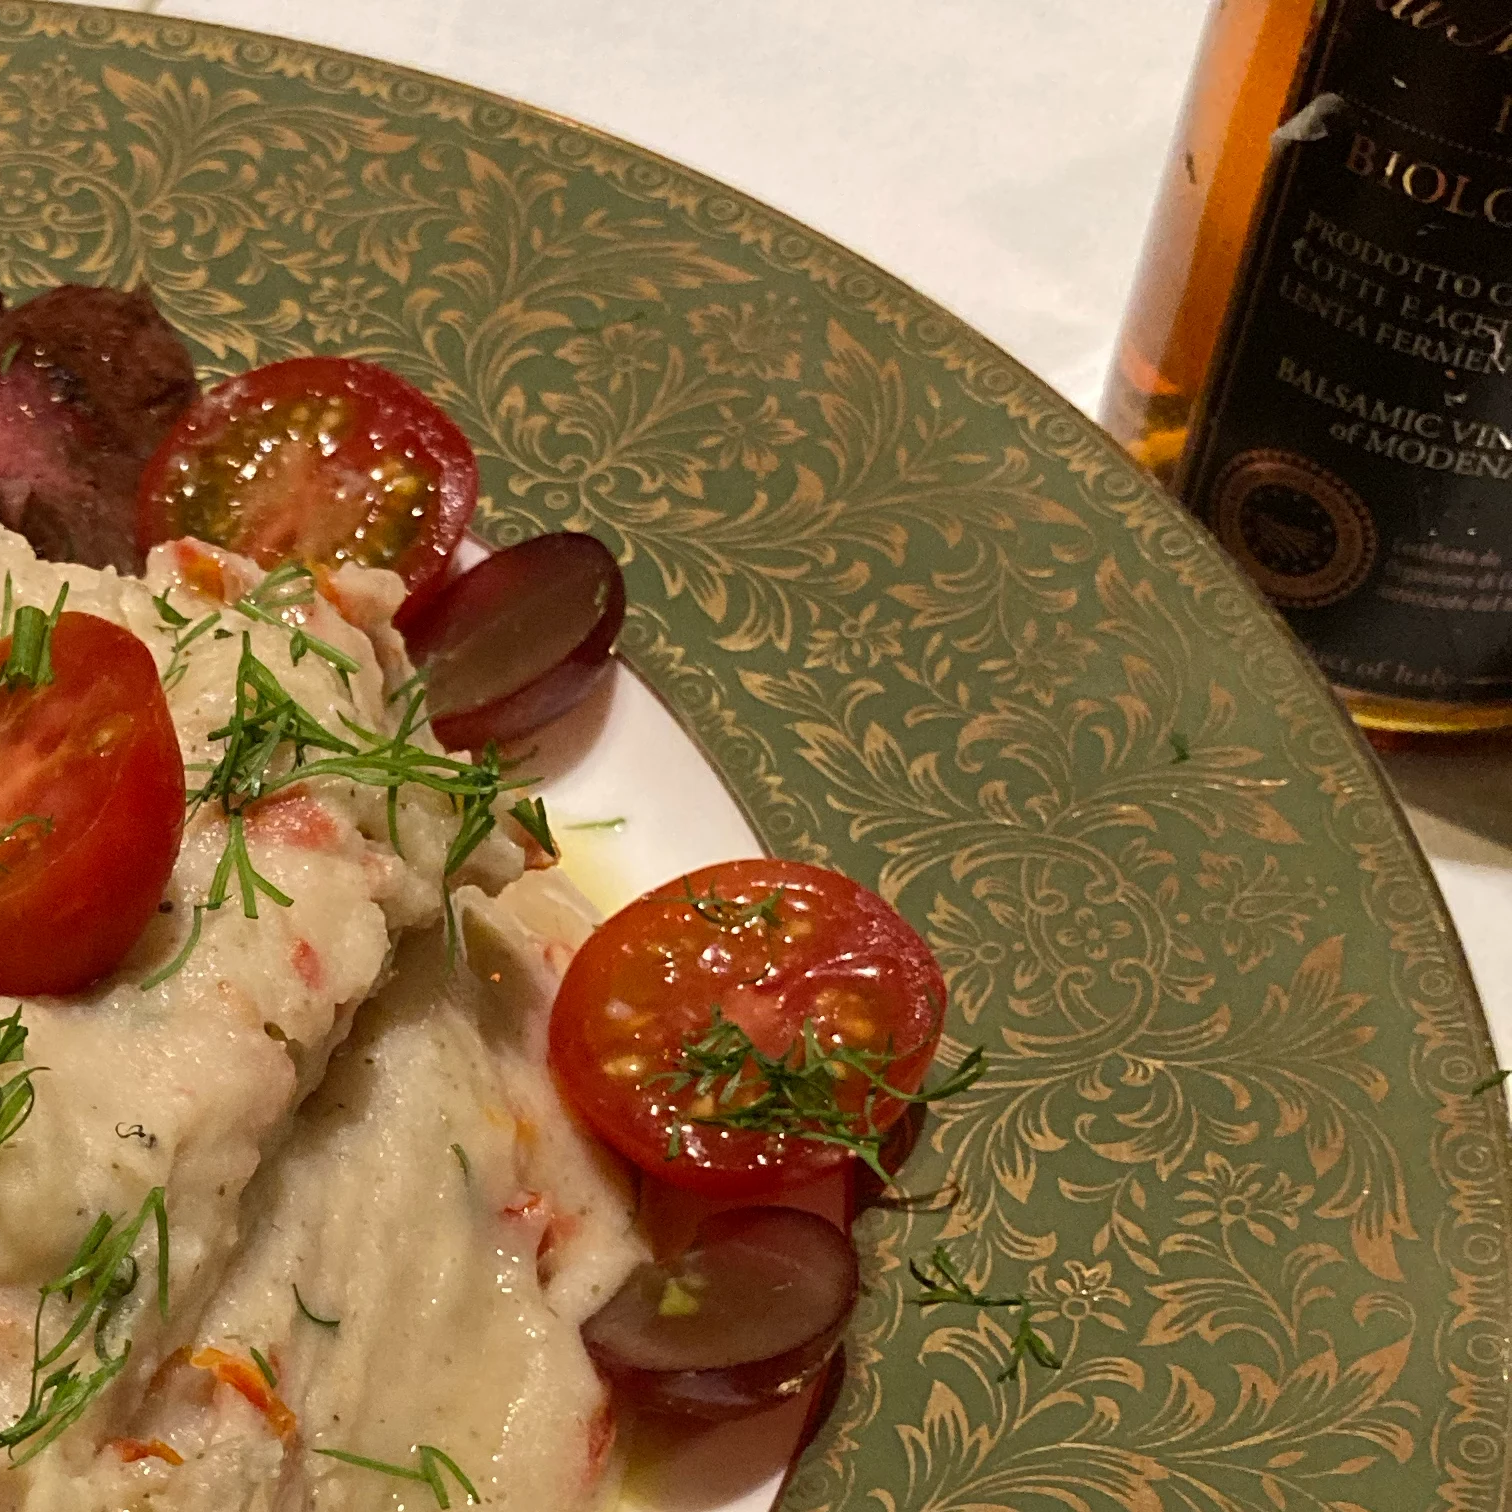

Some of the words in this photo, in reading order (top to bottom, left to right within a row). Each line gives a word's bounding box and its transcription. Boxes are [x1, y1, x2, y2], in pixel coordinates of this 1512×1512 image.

[1292, 237, 1387, 307] COTTI
[1305, 209, 1482, 298] PRODOTTO
[1276, 356, 1443, 438] BALSAMIC
[1329, 421, 1366, 444] of
